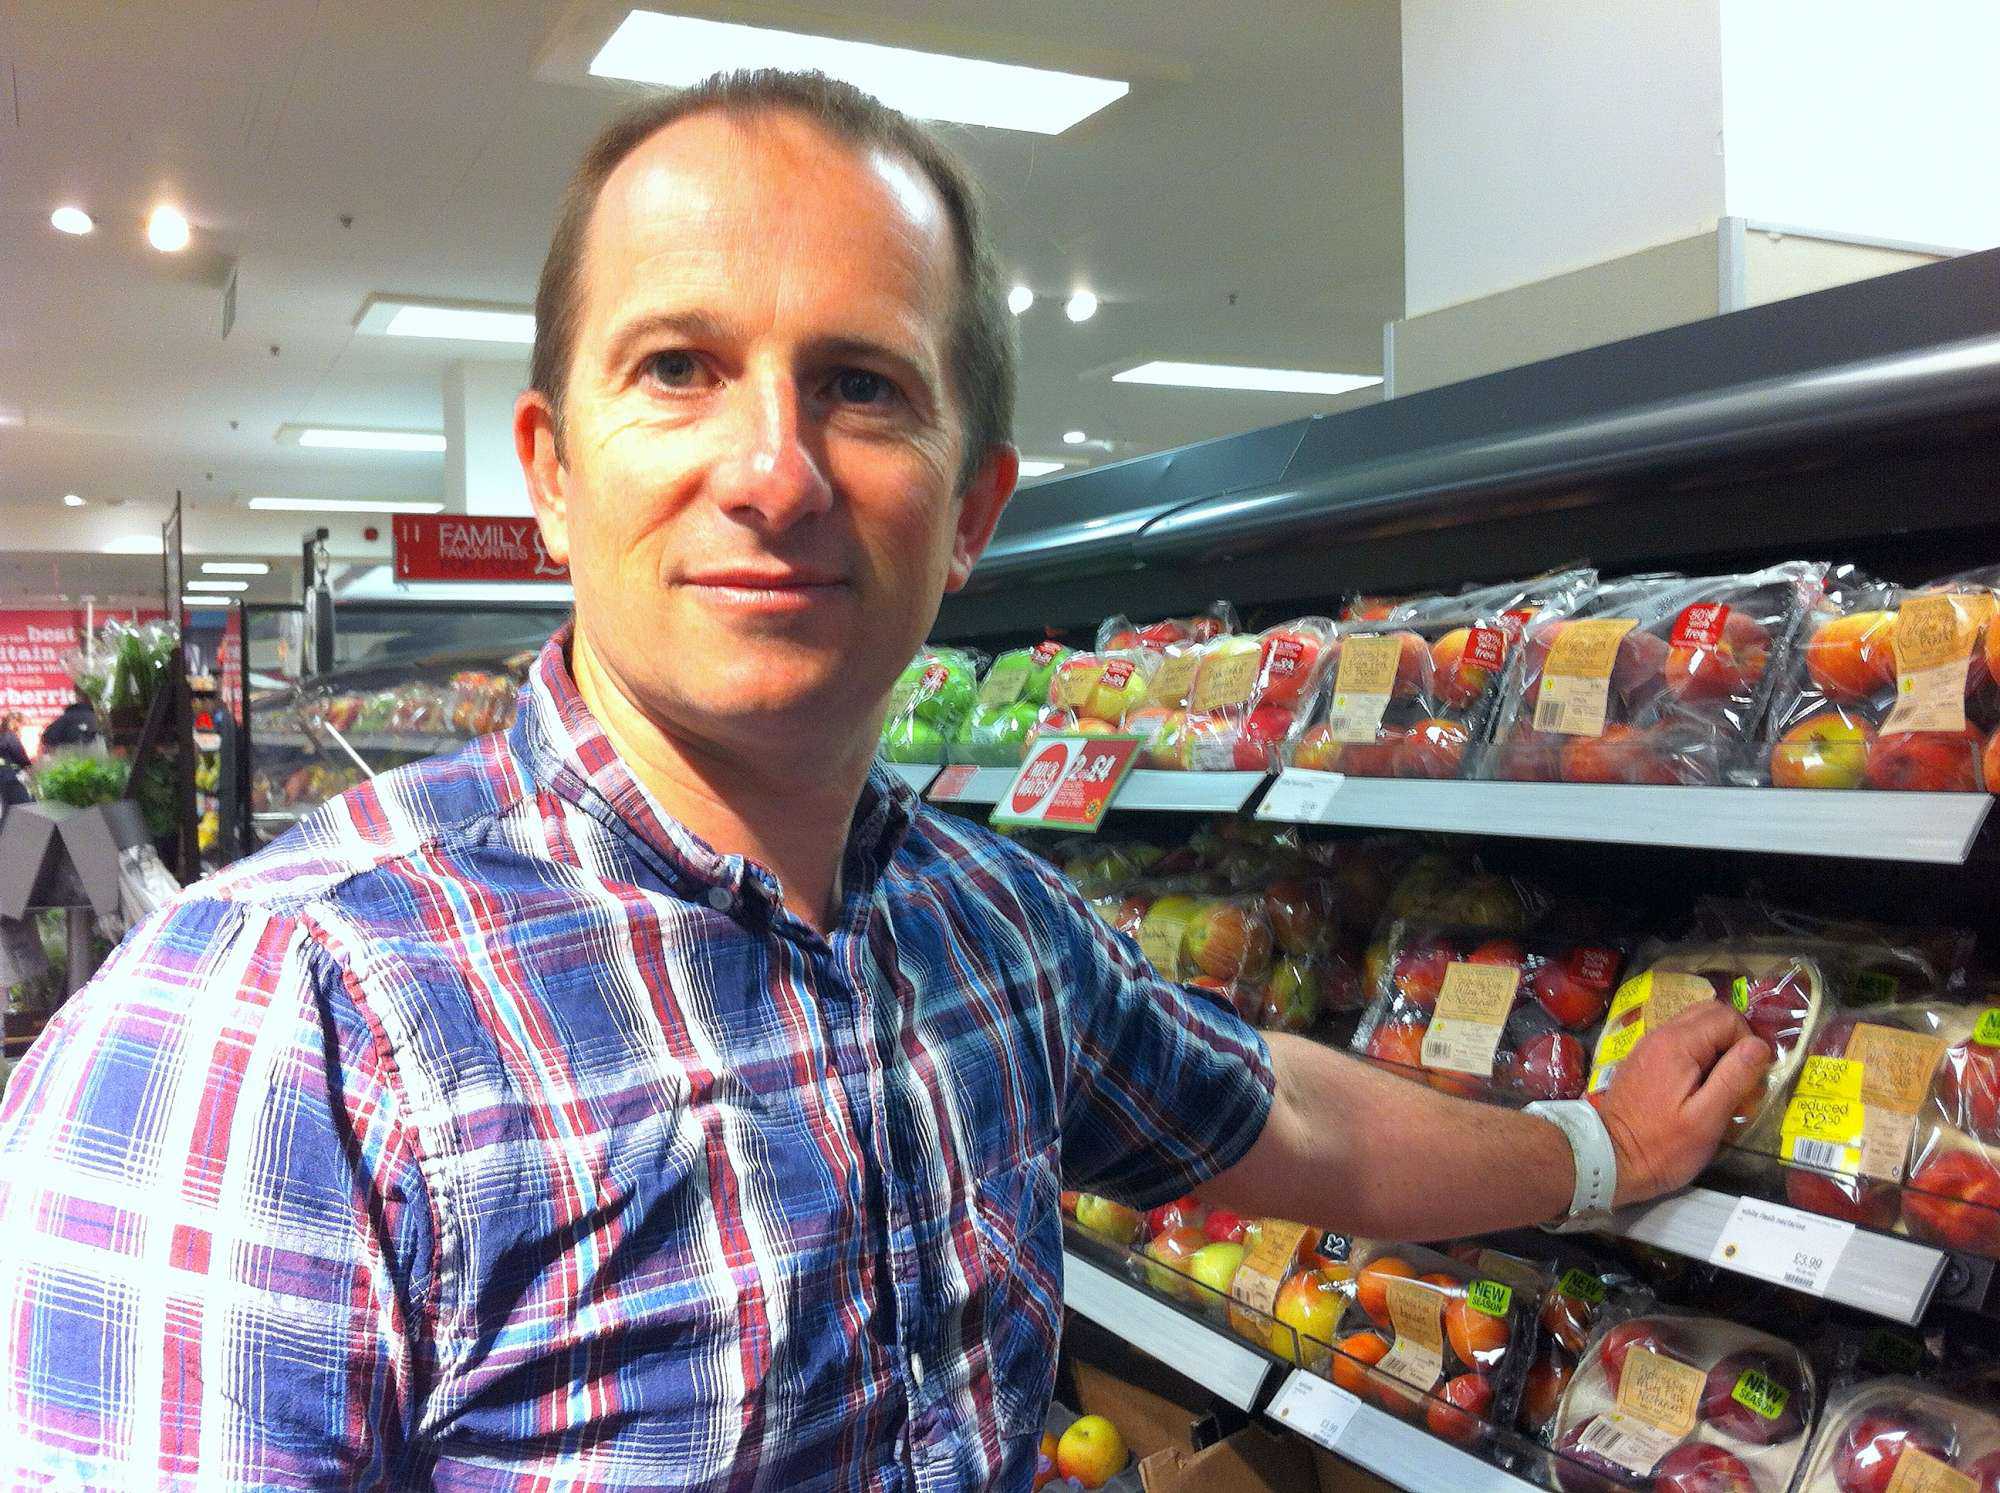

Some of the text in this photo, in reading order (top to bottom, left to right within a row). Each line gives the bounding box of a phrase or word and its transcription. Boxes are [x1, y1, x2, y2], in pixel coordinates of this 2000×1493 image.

[439, 523, 527, 547] FAMILY
[440, 546, 528, 560] FAVOURITES
[27, 624, 75, 642] best
[1796, 1098, 1849, 1116] reduced
[1324, 1233, 1346, 1255] £2
[1793, 1250, 1823, 1272] £3.99
[1474, 1280, 1505, 1303] NEW
[1471, 1296, 1502, 1314] SEASON
[1743, 1371, 1785, 1404] NEW
[1739, 1387, 1776, 1417] SEASON
